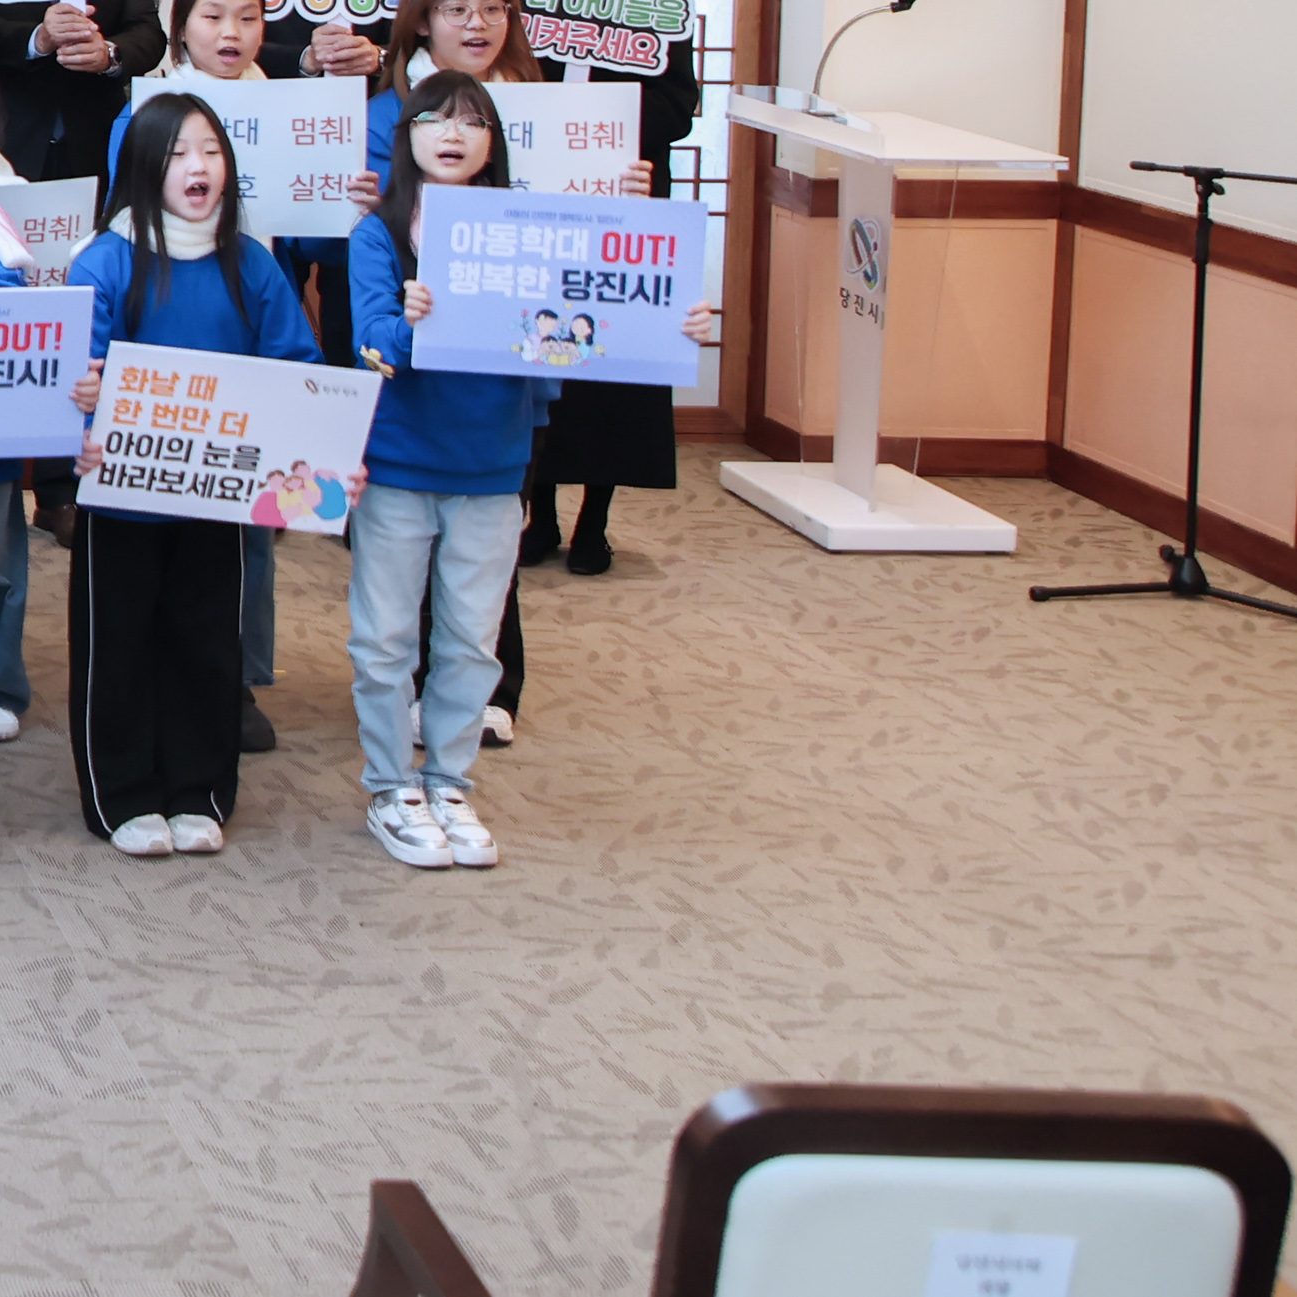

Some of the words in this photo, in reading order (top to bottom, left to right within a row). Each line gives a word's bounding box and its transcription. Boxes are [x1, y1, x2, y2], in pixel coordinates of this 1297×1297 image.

[291, 116, 352, 146] 멈춰!
[565, 122, 624, 151] 멈춰!
[24, 214, 80, 243] 멈춰!
[450, 220, 590, 262] 아동학대
[601, 231, 677, 267] OUT!
[448, 259, 551, 300] 행복한
[561, 269, 672, 307] 당진시!
[117, 366, 180, 398] 화날
[187, 374, 219, 403] 때
[112, 397, 143, 426] 한
[150, 402, 211, 434] 번만
[218, 410, 249, 439] 더
[106, 430, 193, 464] 아이의
[203, 441, 261, 472] 눈을
[97, 462, 255, 504] 바라보세요!
